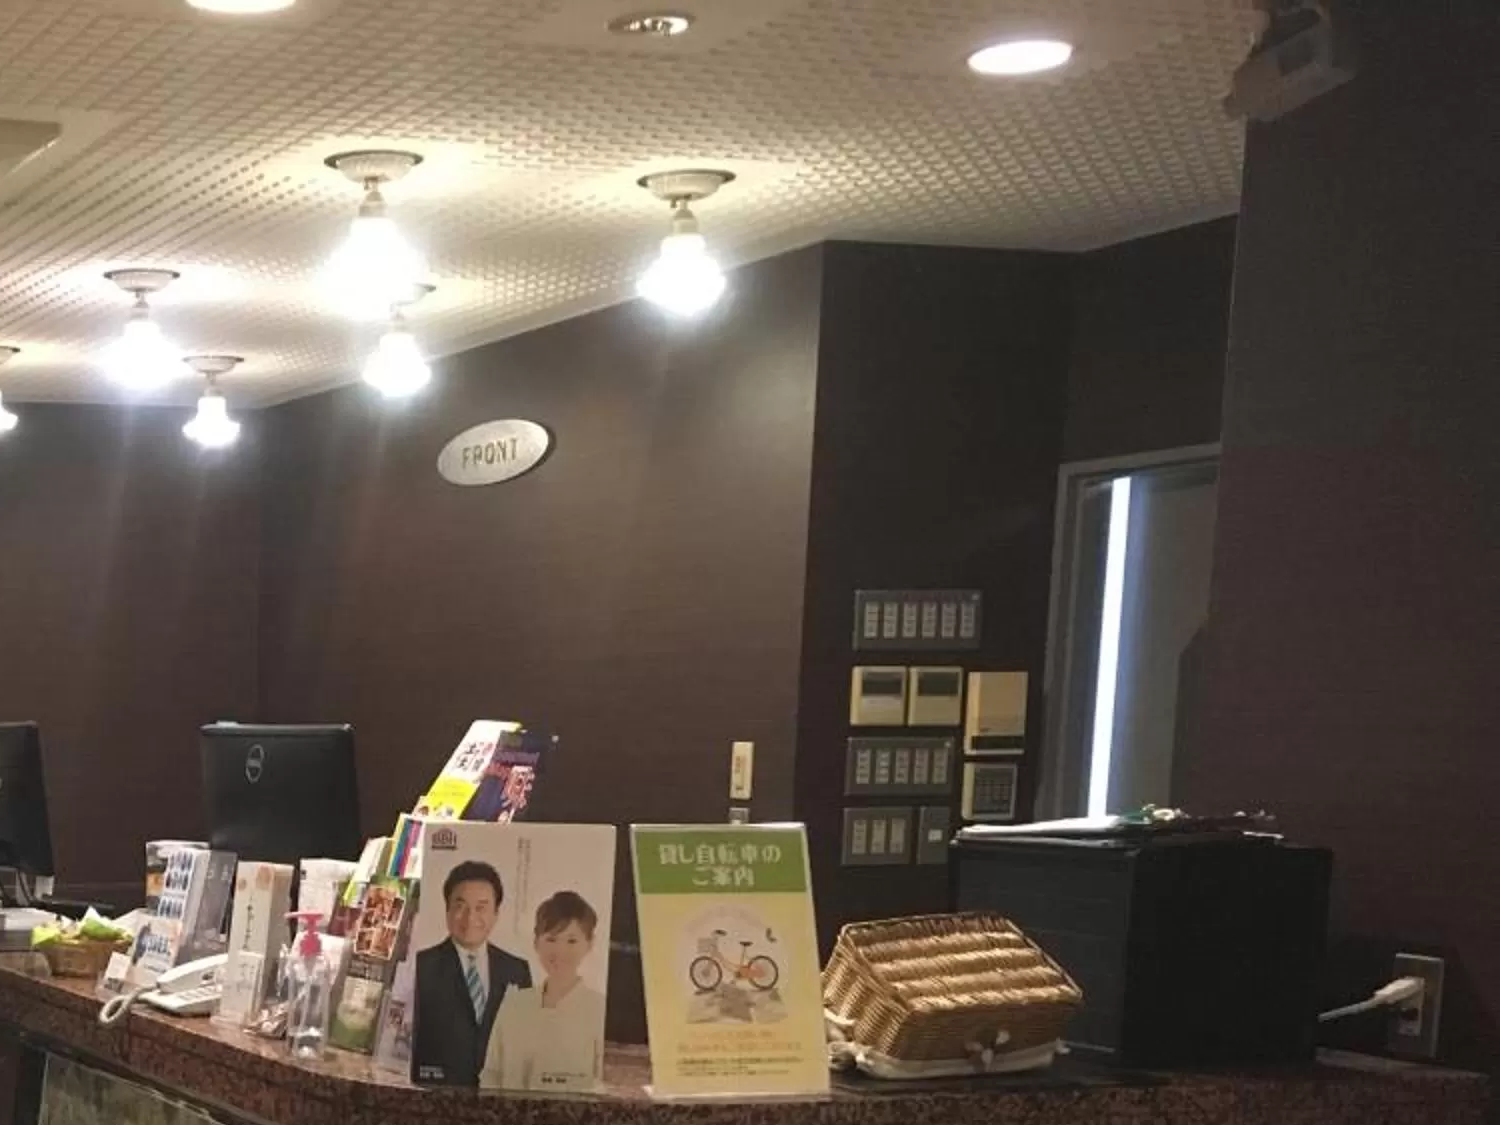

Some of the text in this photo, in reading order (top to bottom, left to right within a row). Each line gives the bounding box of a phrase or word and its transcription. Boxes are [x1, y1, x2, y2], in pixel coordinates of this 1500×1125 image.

[462, 439, 517, 469] FRONT
[691, 865, 755, 887] ご案内
